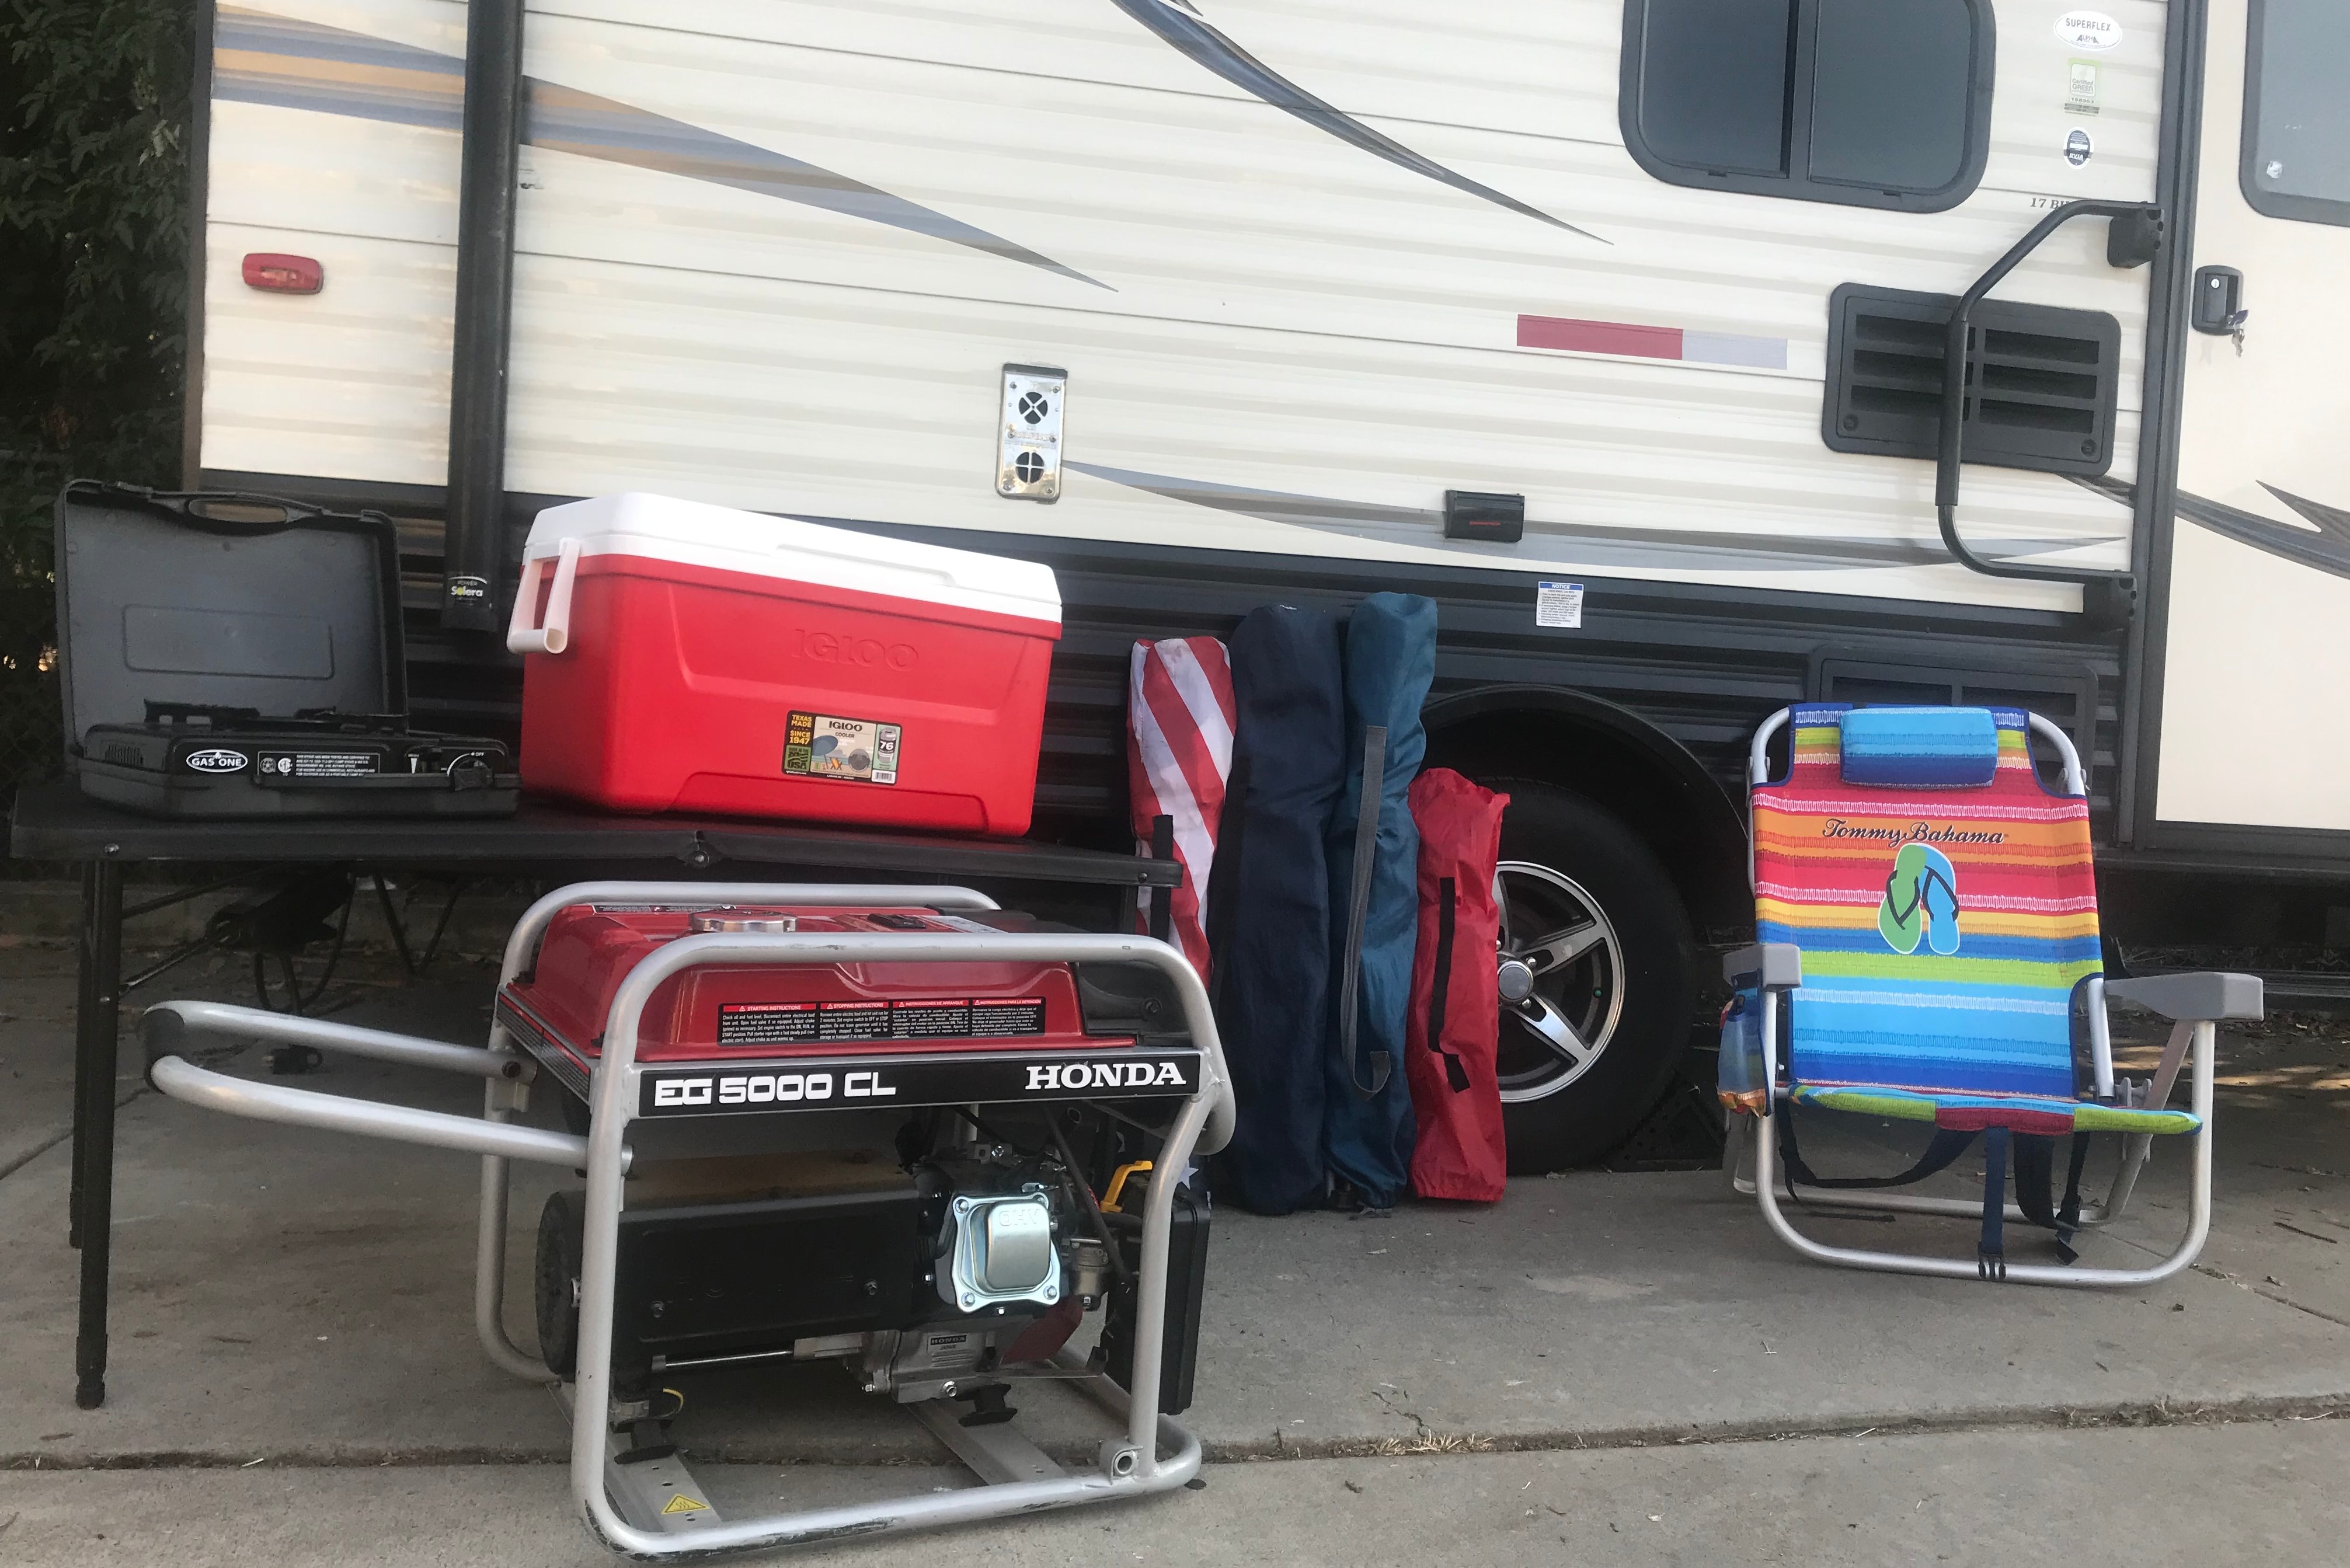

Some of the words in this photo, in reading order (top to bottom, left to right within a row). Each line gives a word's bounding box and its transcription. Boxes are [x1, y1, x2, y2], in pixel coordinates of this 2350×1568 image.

[2066, 18, 2111, 32] SUPERFLEX
[2030, 197, 2047, 208] 17
[451, 586, 483, 597] Solera
[791, 628, 919, 672] IGLOO
[829, 721, 862, 732] IGLOO
[790, 730, 810, 738] SINCE
[789, 737, 810, 745] 1947
[880, 740, 894, 750] 76
[192, 758, 215, 766] GAS
[218, 758, 242, 766] ONE
[787, 759, 807, 769] USA
[1822, 818, 1903, 847] Tommy
[1904, 821, 2004, 844] Bahama
[1025, 1062, 1186, 1090] HONDA
[654, 1078, 712, 1106] EG
[719, 1074, 833, 1104] 5000
[844, 1072, 896, 1097] CL
